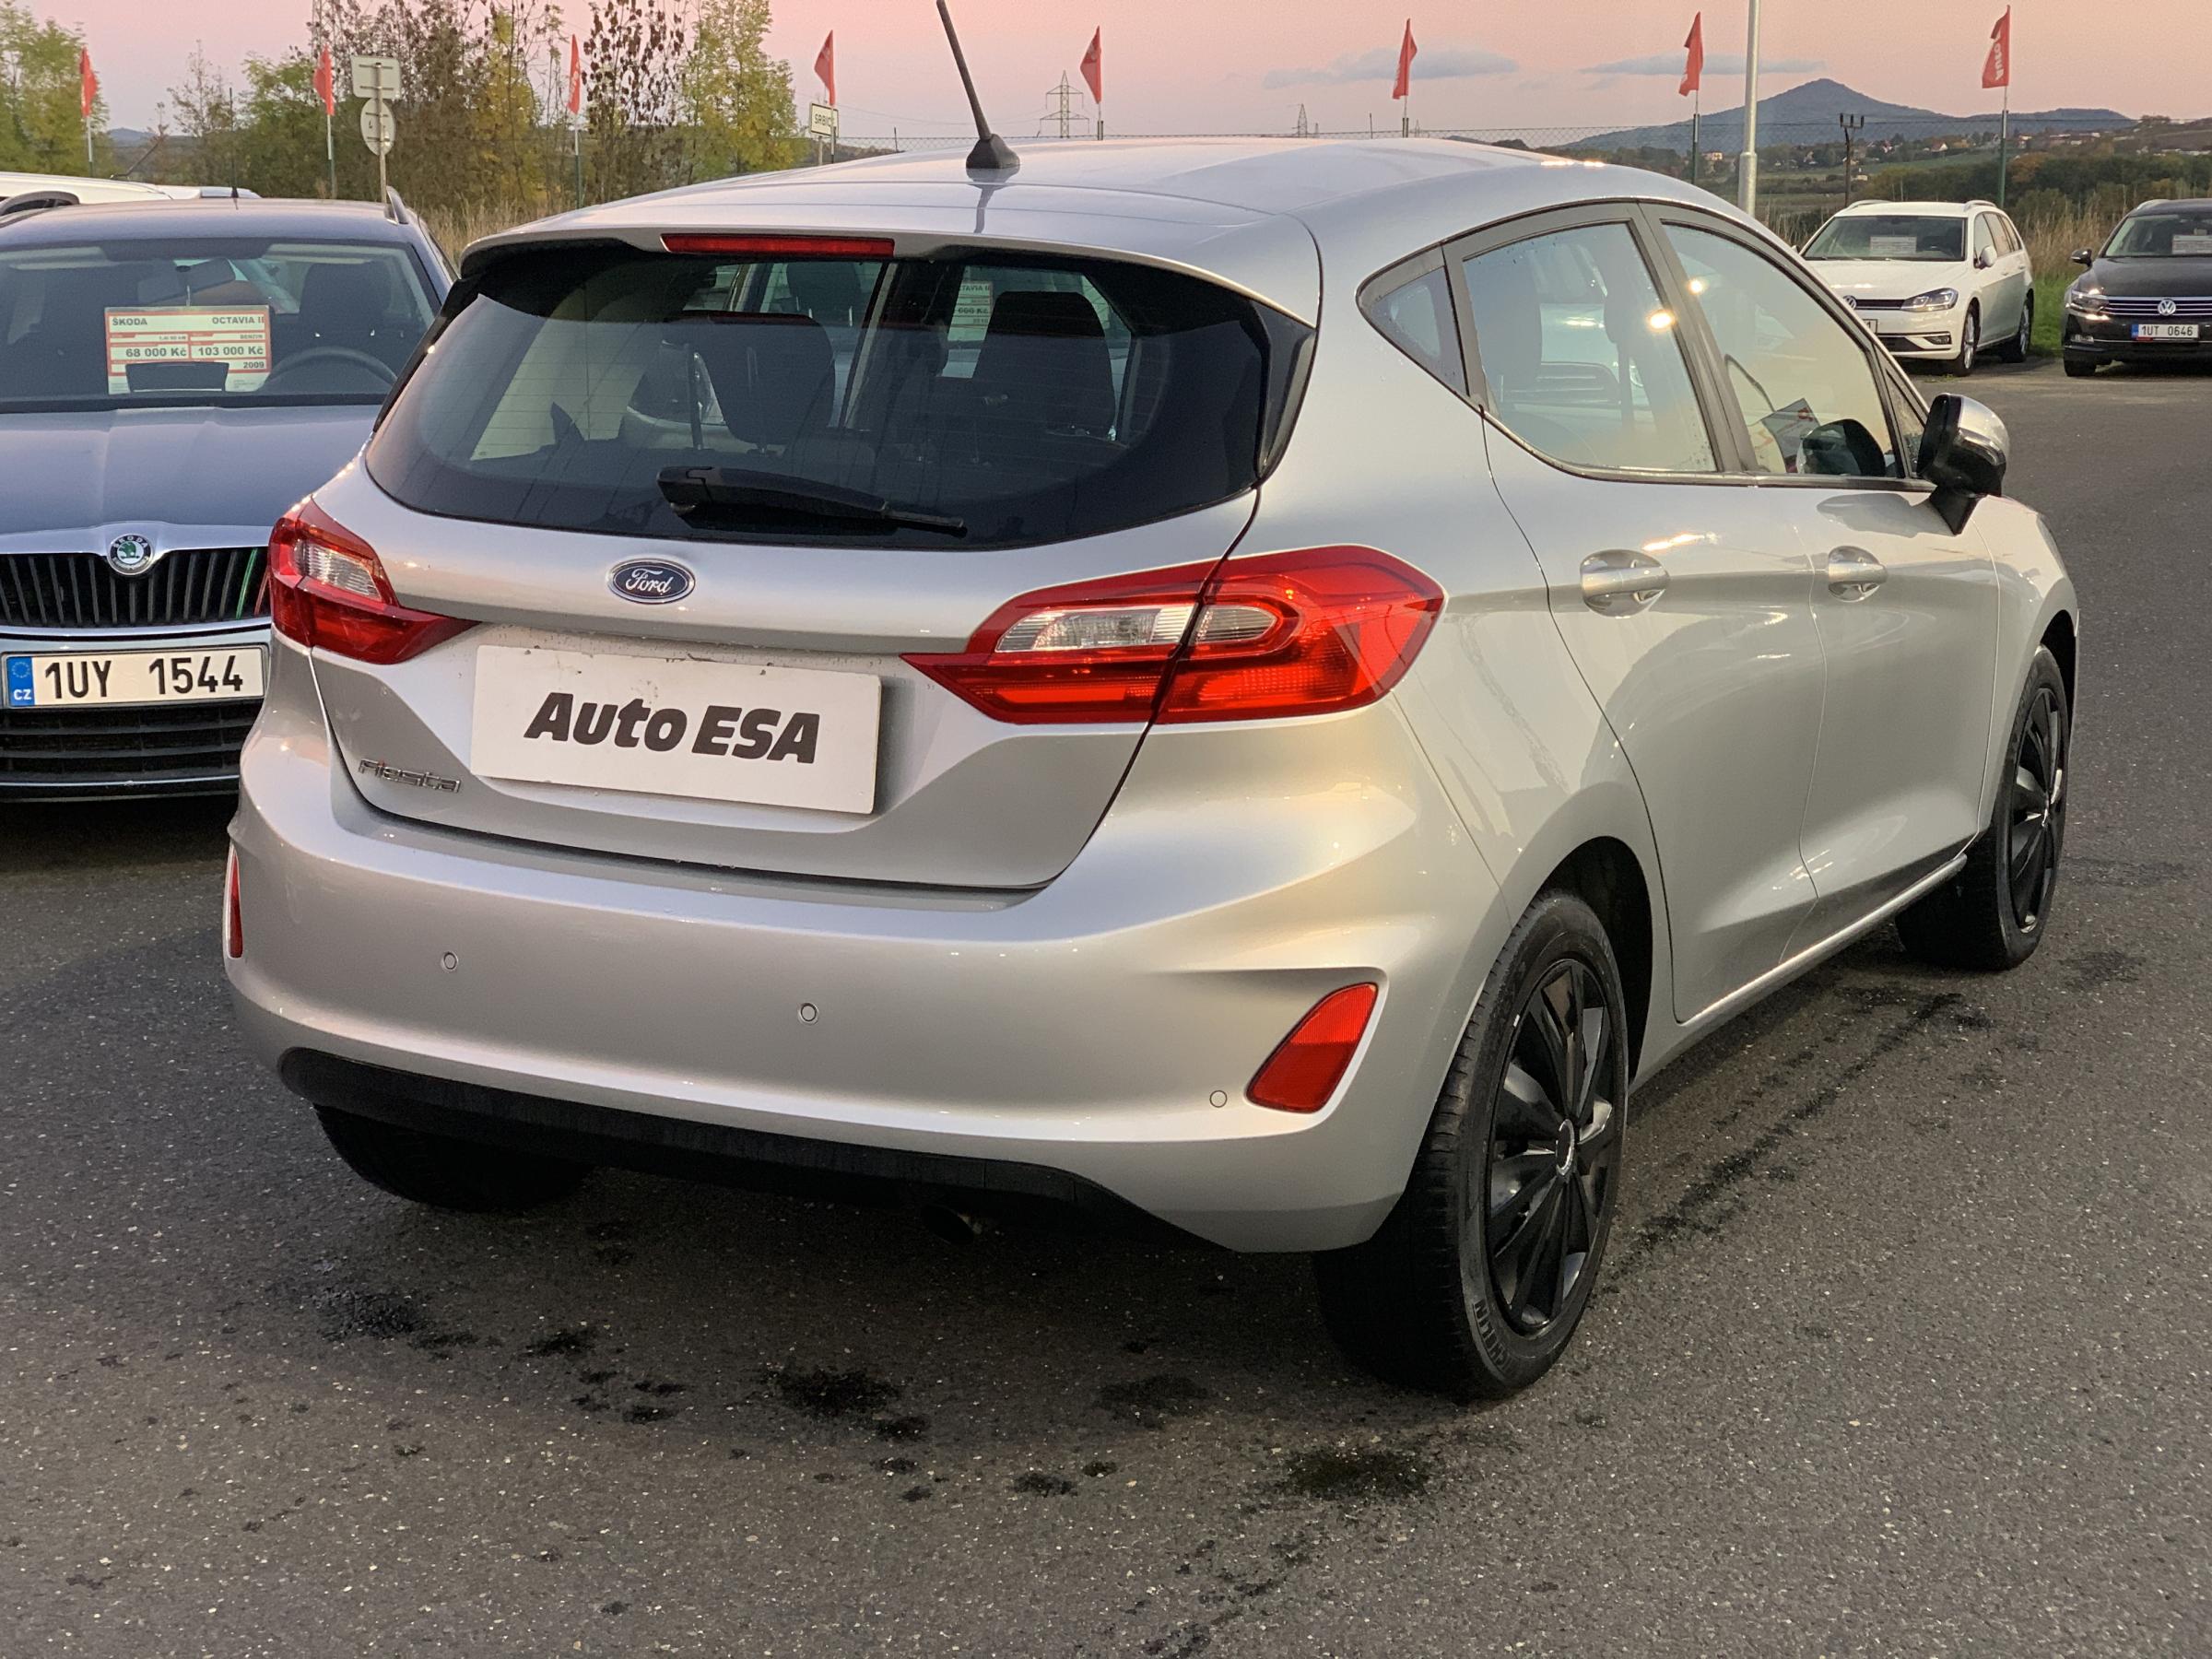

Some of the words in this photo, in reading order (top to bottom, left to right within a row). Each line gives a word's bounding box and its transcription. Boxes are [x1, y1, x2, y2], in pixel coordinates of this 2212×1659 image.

[212, 316, 254, 324] OCTAVIA
[2142, 325, 2159, 335] 1UT
[2168, 325, 2194, 335] 0646
[125, 348, 140, 358] 68
[145, 347, 166, 357] 000
[171, 347, 187, 357] Kč
[198, 347, 219, 356] 103
[223, 347, 244, 356] 000
[248, 346, 264, 355] Kč
[625, 568, 674, 594] Ford
[13, 688, 32, 700] CZ
[45, 660, 112, 700] 1UY
[148, 655, 243, 695] 1544
[524, 691, 688, 752] Auto
[691, 705, 820, 764] ESA
[358, 758, 462, 794] Fiesta
[1473, 1298, 1517, 1376] ICHELIN
